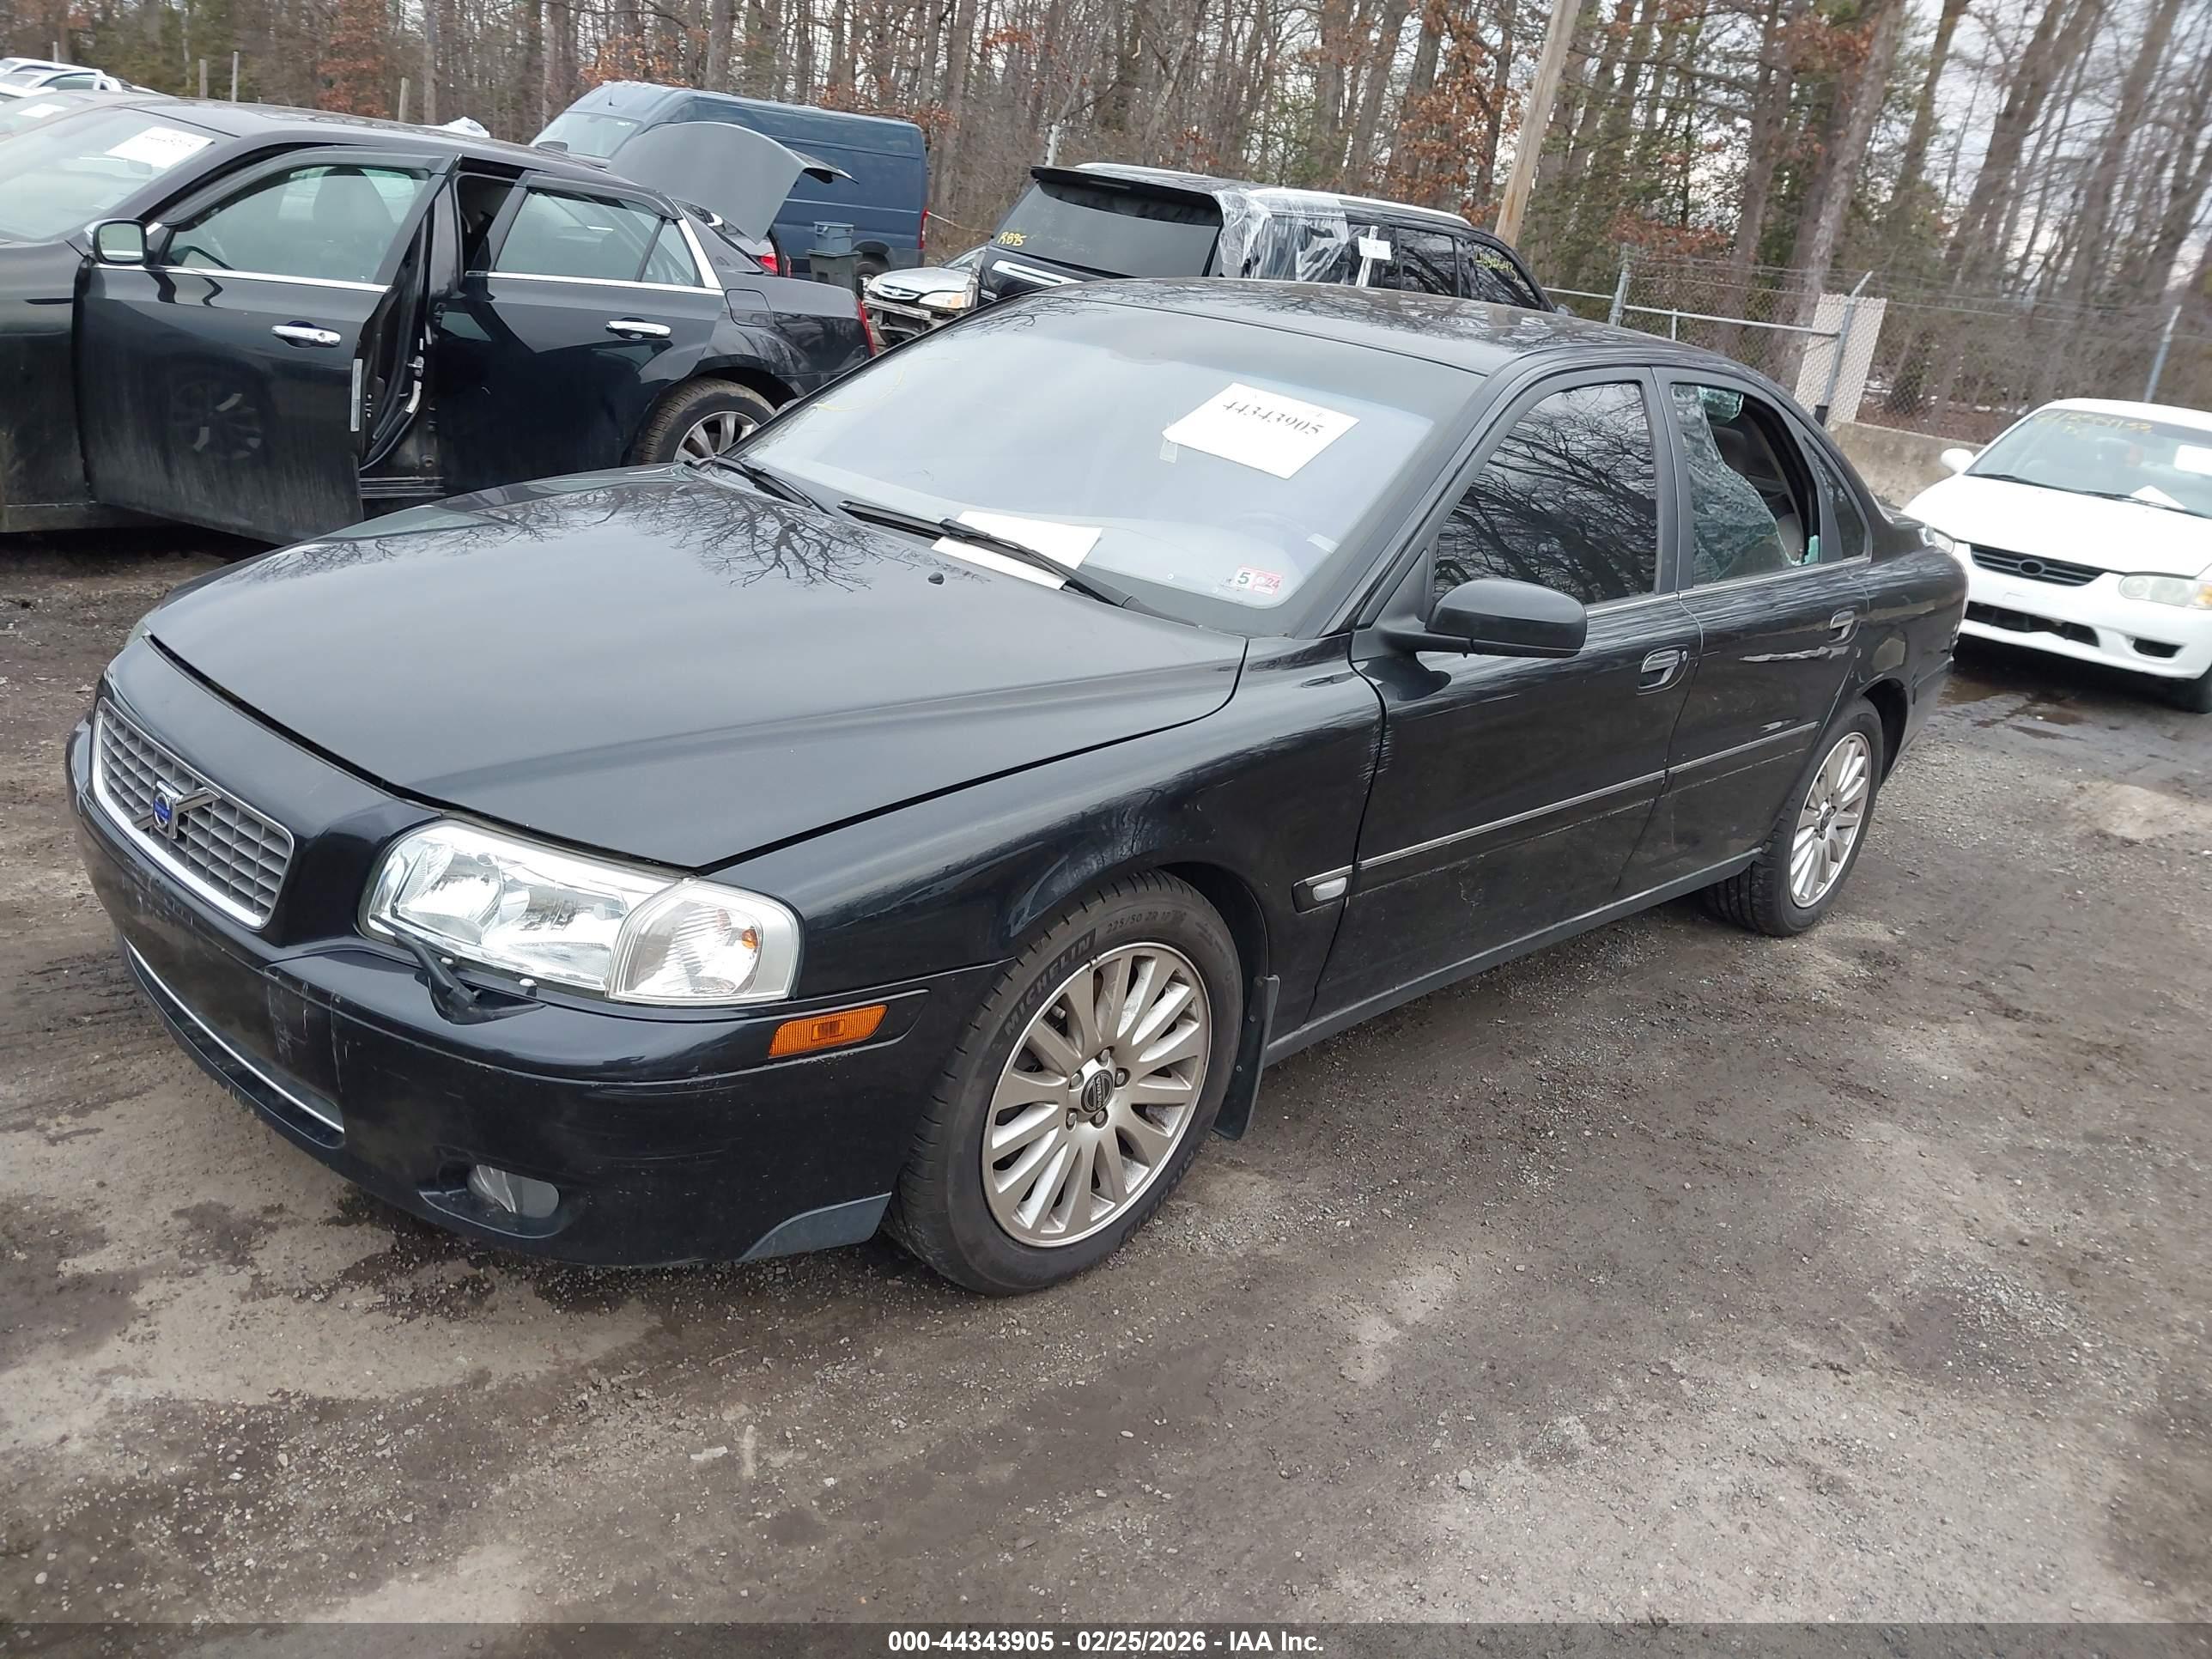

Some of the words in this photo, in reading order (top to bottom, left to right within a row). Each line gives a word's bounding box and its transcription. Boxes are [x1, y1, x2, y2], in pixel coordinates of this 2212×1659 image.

[1223, 401, 1325, 434] 44343905
[1237, 572, 1251, 585] 5
[1003, 934, 1091, 1036] MICHELIN
